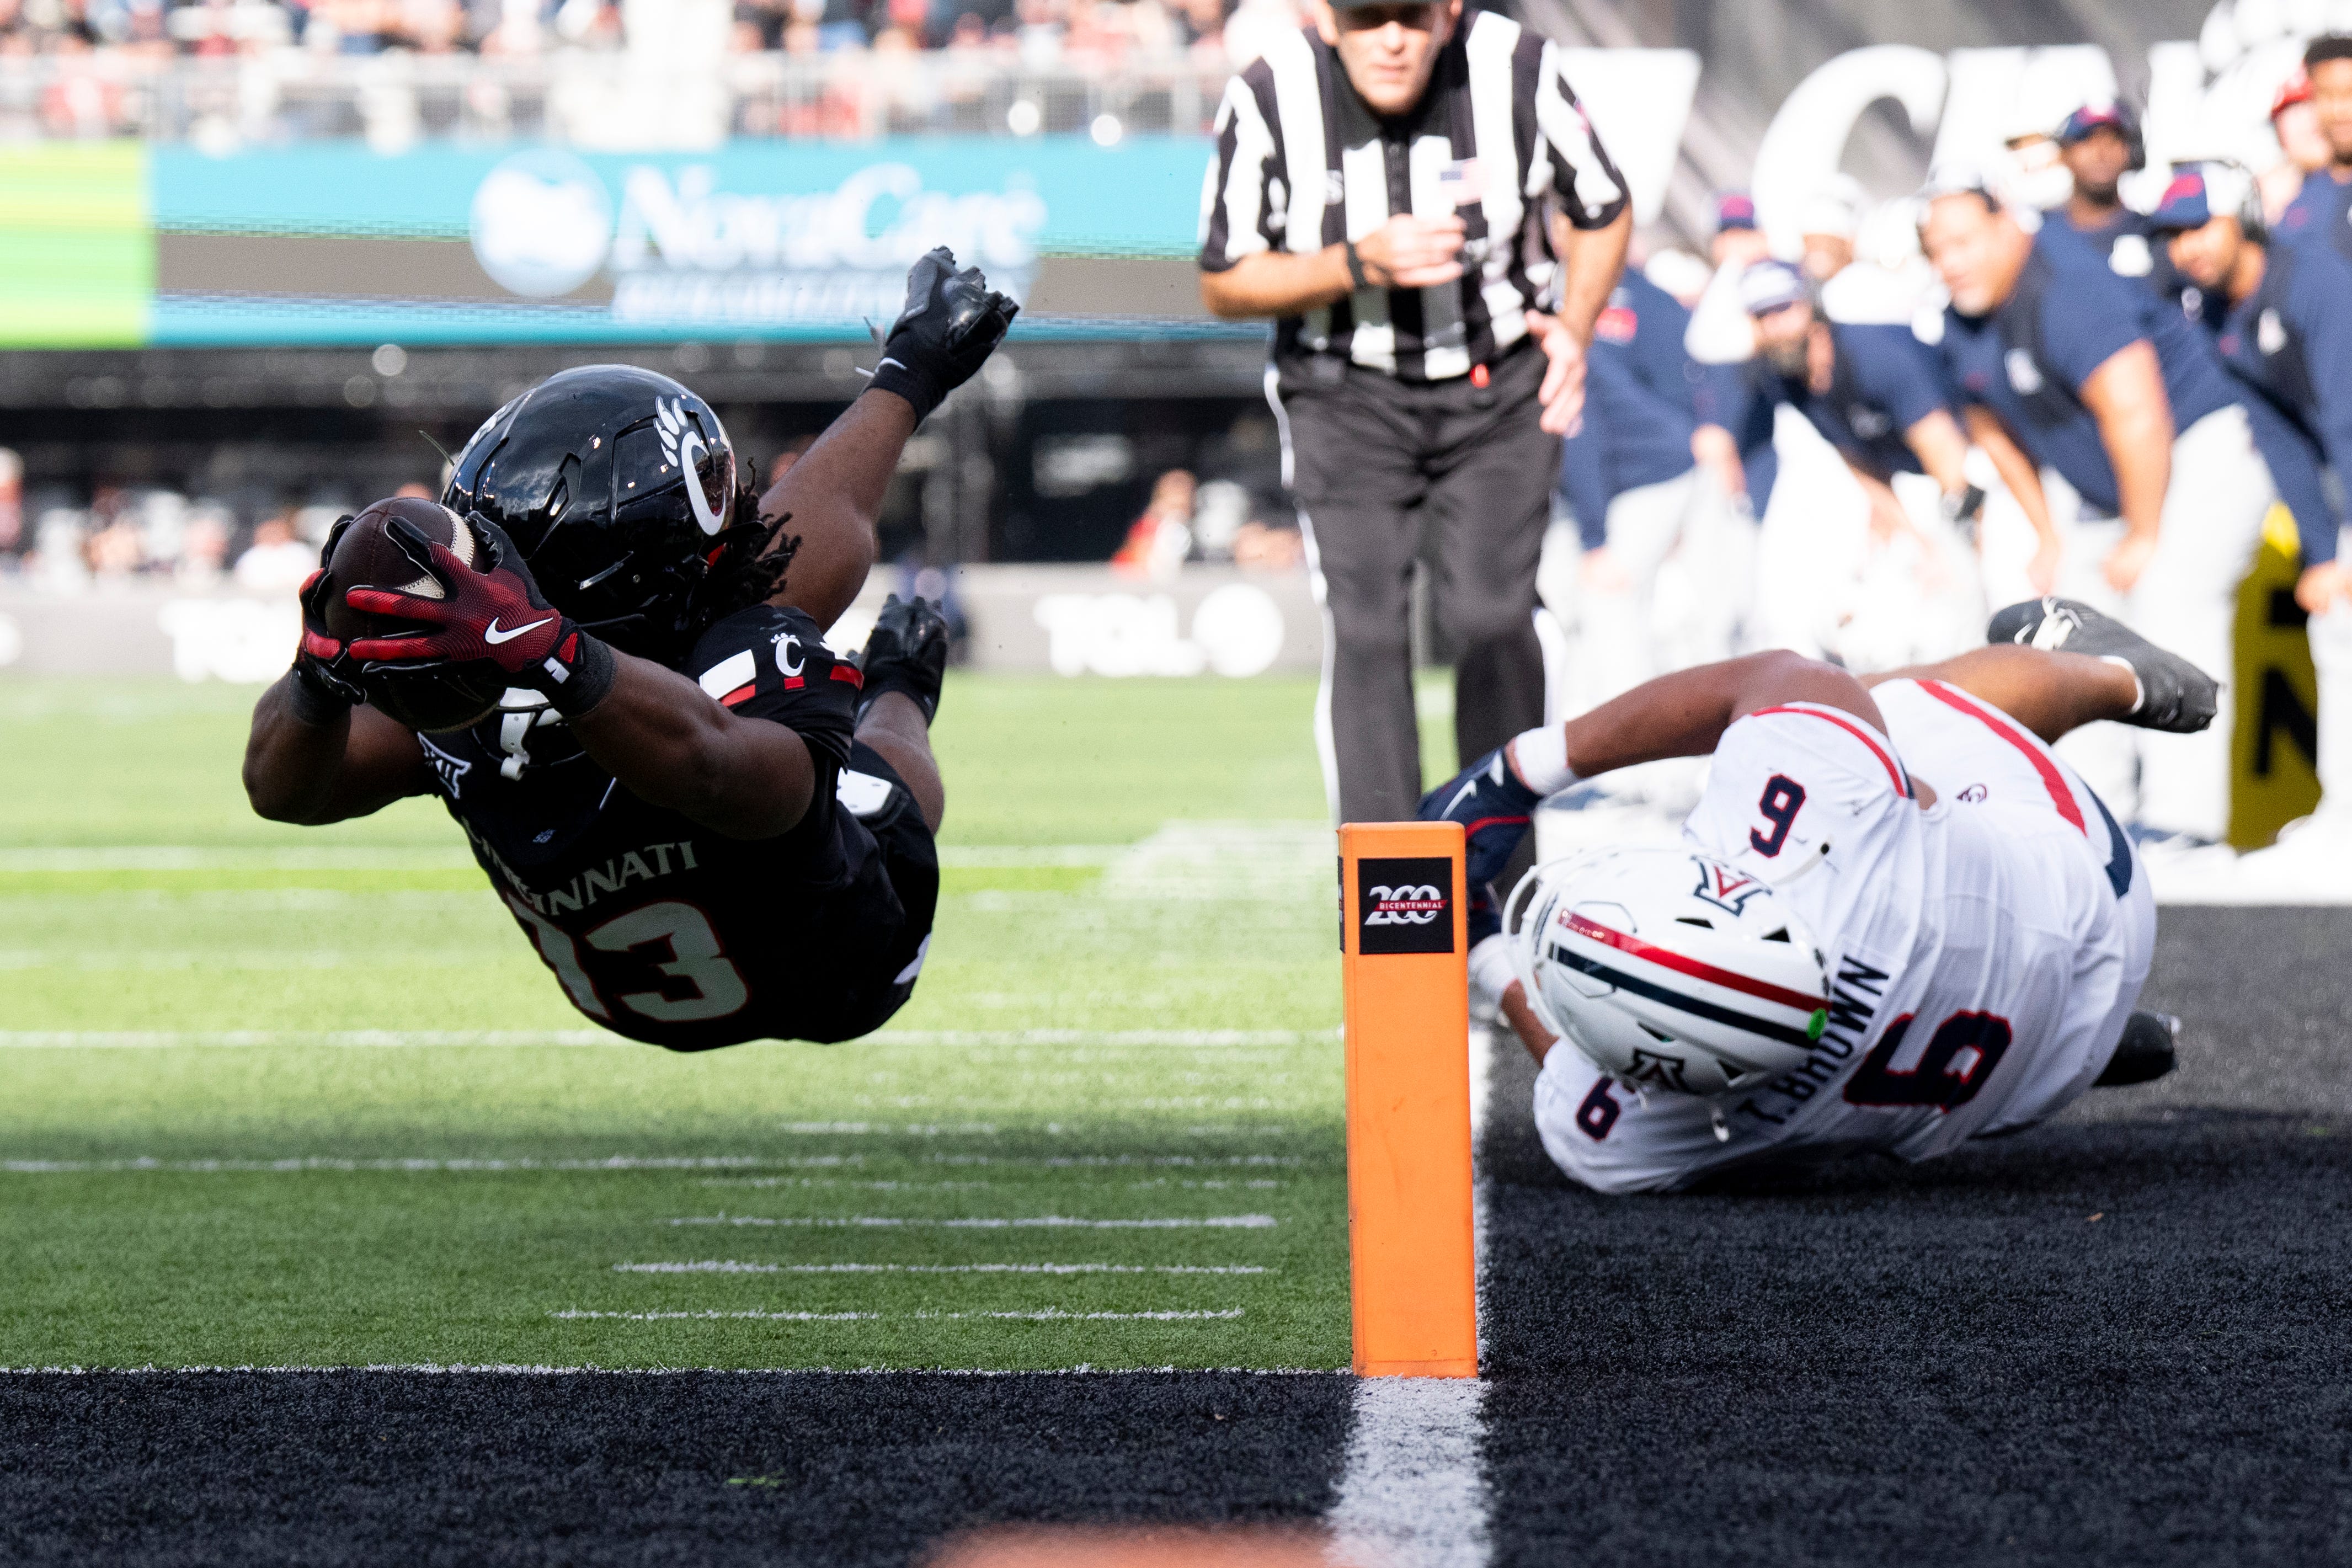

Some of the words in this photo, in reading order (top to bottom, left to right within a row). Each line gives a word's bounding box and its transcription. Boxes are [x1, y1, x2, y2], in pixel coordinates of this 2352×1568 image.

[1364, 885, 1442, 925] 200
[1379, 901, 1443, 910] BICENTENNIAL
[1575, 1075, 1635, 1142] 6
